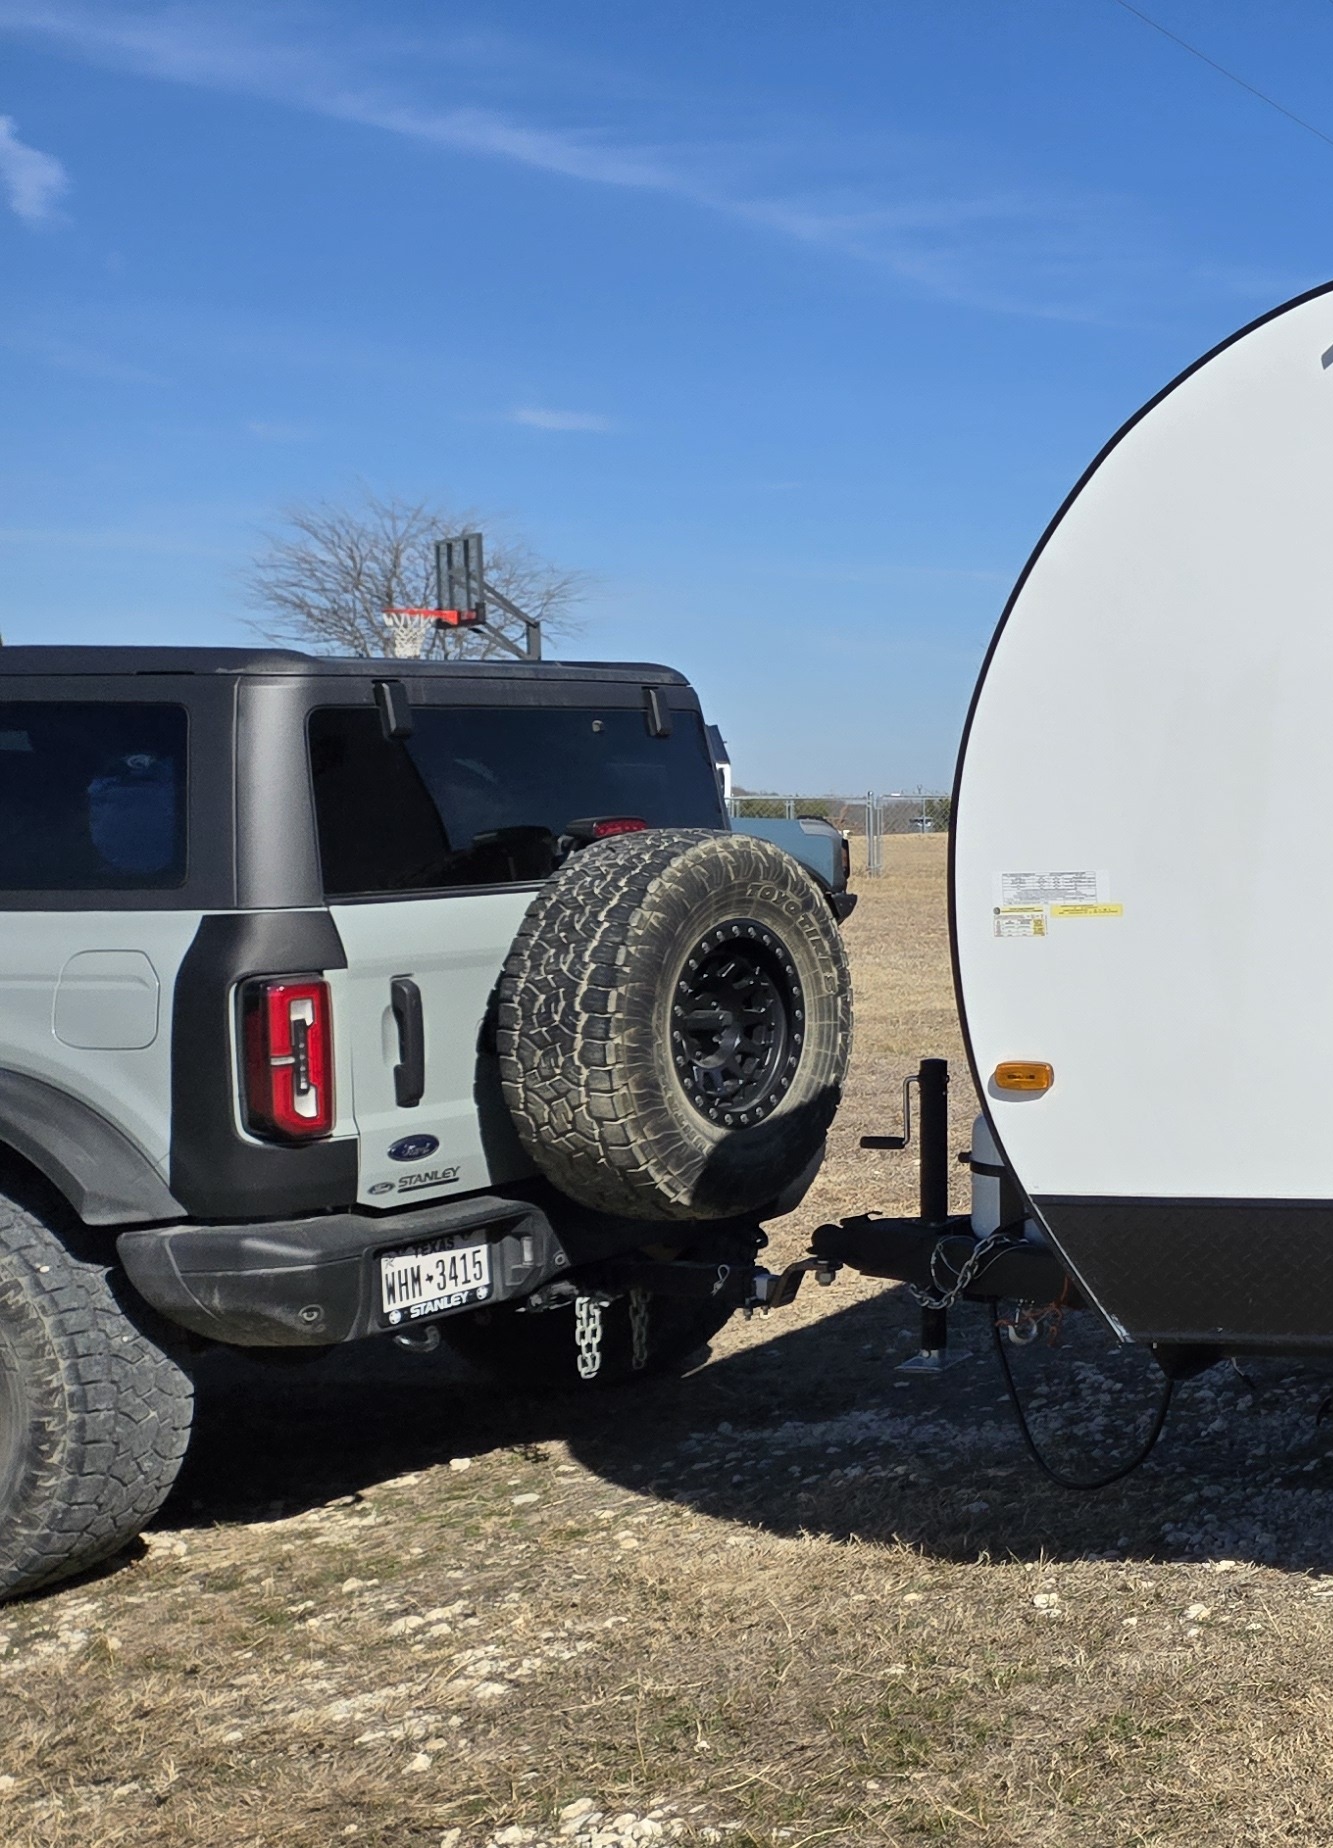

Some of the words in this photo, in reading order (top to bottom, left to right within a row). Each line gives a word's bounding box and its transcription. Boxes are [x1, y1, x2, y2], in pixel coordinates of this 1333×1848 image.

[745, 881, 803, 919] TOYO
[796, 911, 839, 995] TIRES
[398, 1166, 461, 1188] STANLEY
[414, 1238, 455, 1259] TEXAS
[385, 1264, 423, 1306] WHM
[435, 1248, 483, 1291] 3415
[409, 1291, 470, 1319] STANLEY
